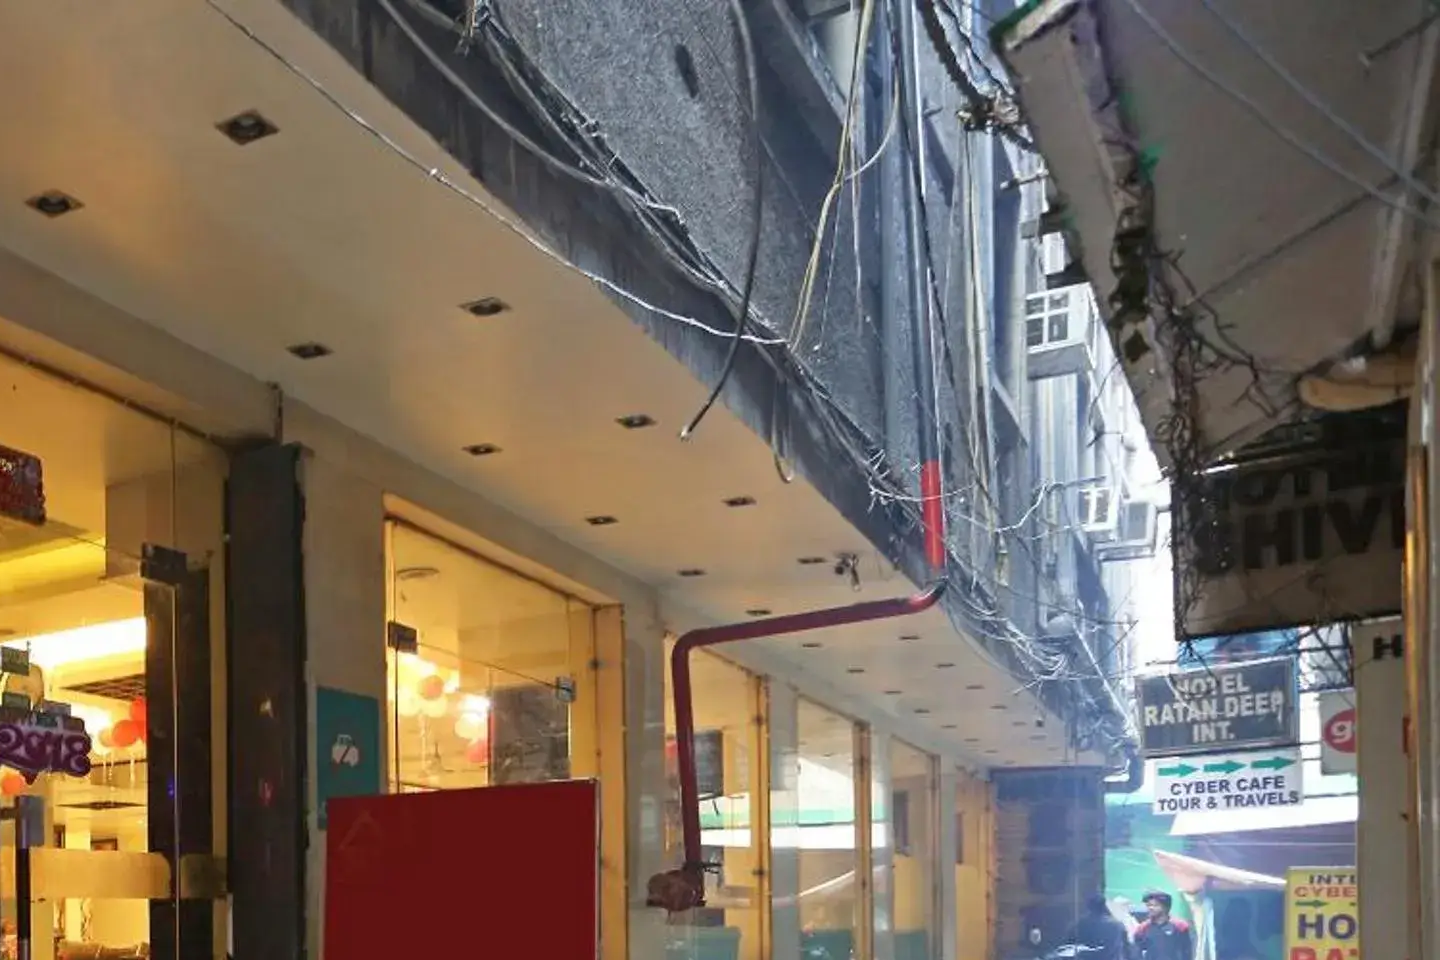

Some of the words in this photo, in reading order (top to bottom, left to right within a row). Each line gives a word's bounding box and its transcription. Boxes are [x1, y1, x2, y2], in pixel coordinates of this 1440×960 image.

[1144, 696, 1217, 726] RATAN
[1192, 721, 1236, 743] INT.
[1170, 777, 1231, 796] CYBER
[1237, 775, 1285, 792] CAFE
[1158, 797, 1200, 812] TOUR
[1207, 796, 1218, 810] &
[1225, 790, 1300, 809] TRAVELS
